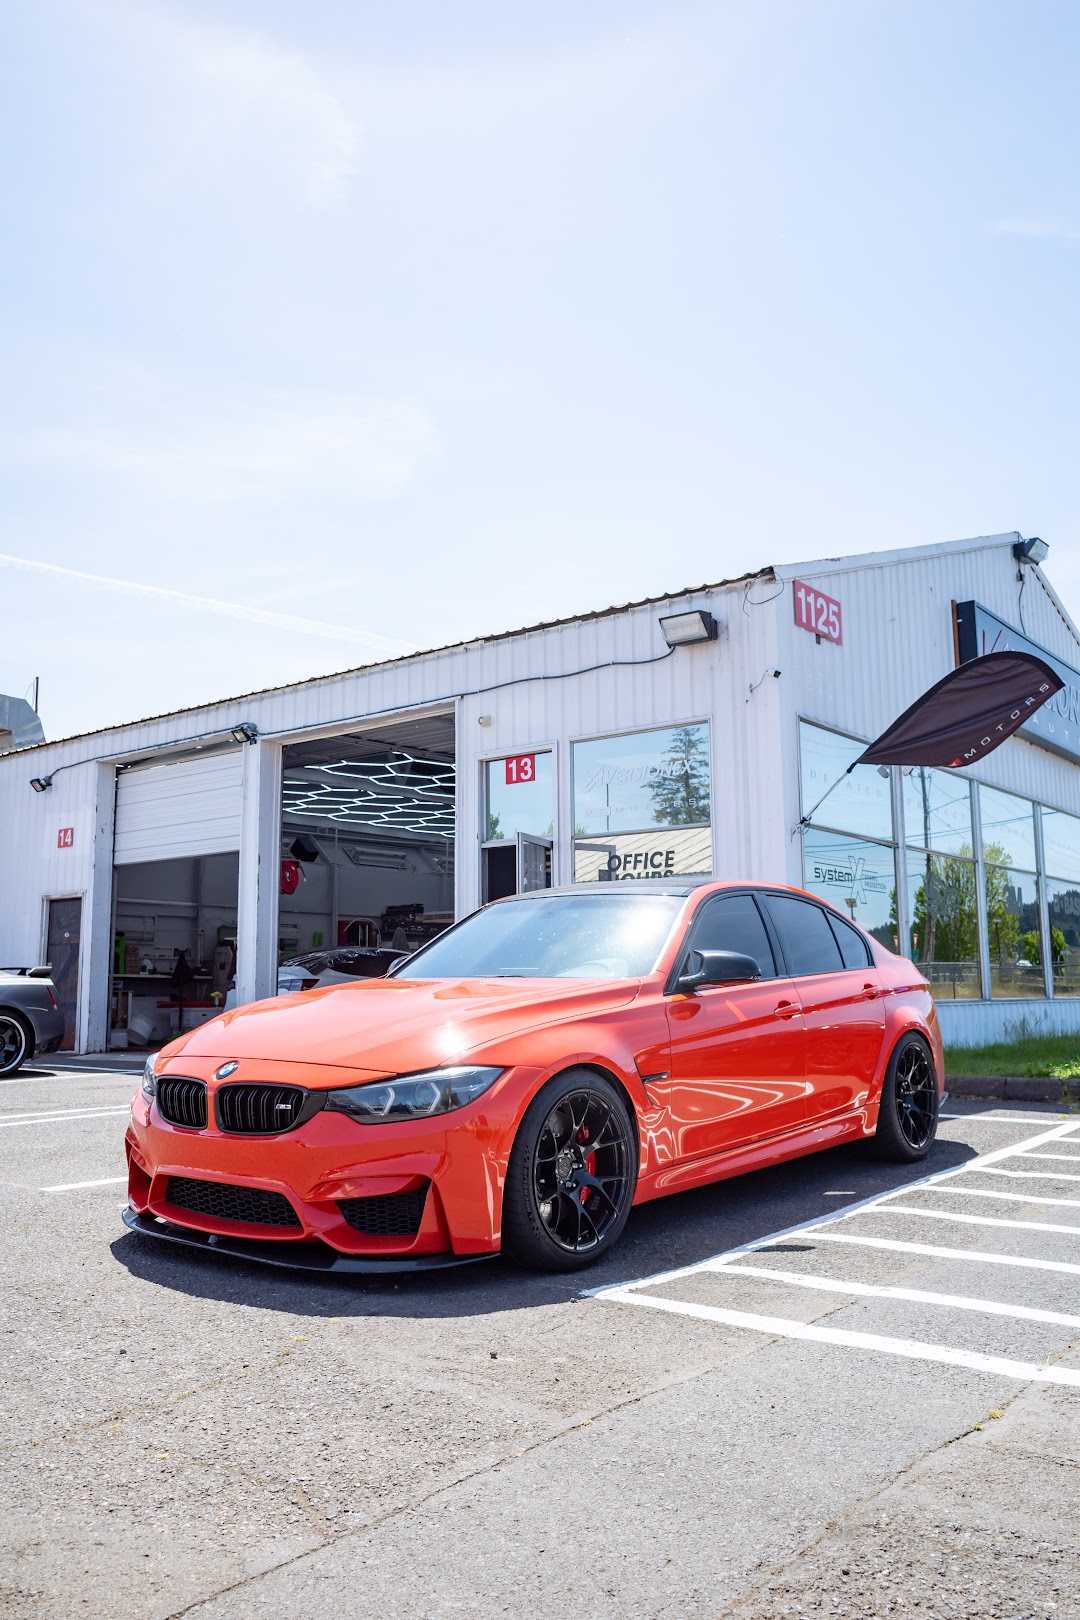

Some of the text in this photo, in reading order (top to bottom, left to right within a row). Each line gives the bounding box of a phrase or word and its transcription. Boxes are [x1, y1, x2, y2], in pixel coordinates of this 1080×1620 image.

[797, 587, 840, 639] 1125
[964, 683, 1050, 759] MOTORS
[508, 757, 533, 782] 13
[59, 829, 72, 847] 14
[607, 850, 675, 872] OFFICE
